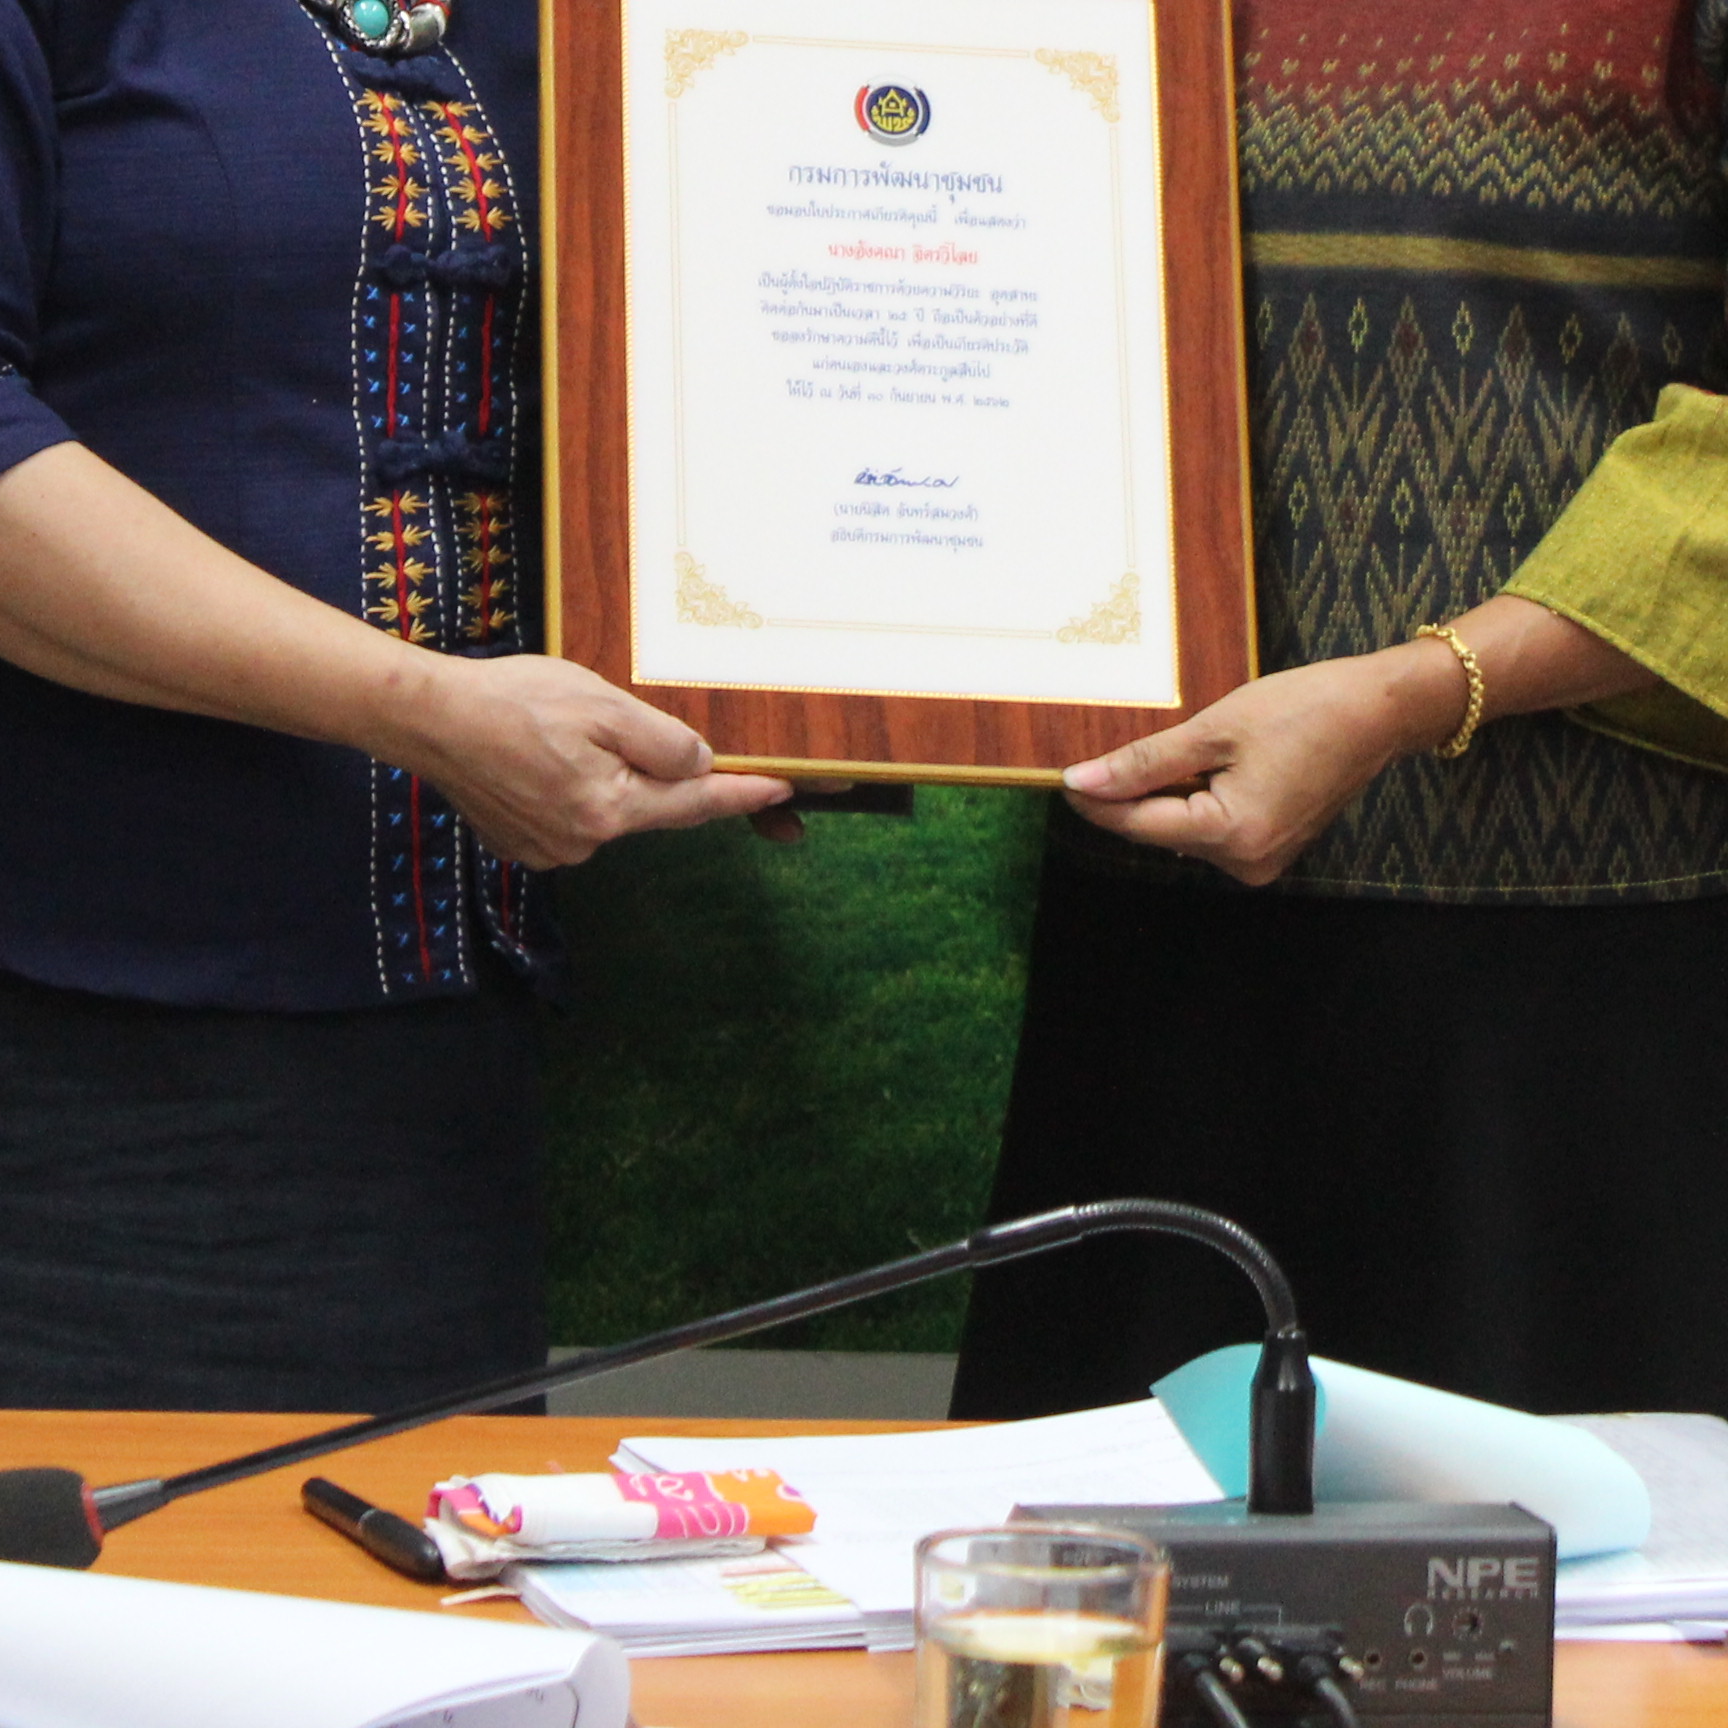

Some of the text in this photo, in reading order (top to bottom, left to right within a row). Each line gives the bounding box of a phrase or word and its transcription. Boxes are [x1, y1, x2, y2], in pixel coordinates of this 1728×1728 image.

[788, 161, 1003, 204] กรมการพัฒนาชุมชน
[1428, 1557, 1539, 1588] NPE
